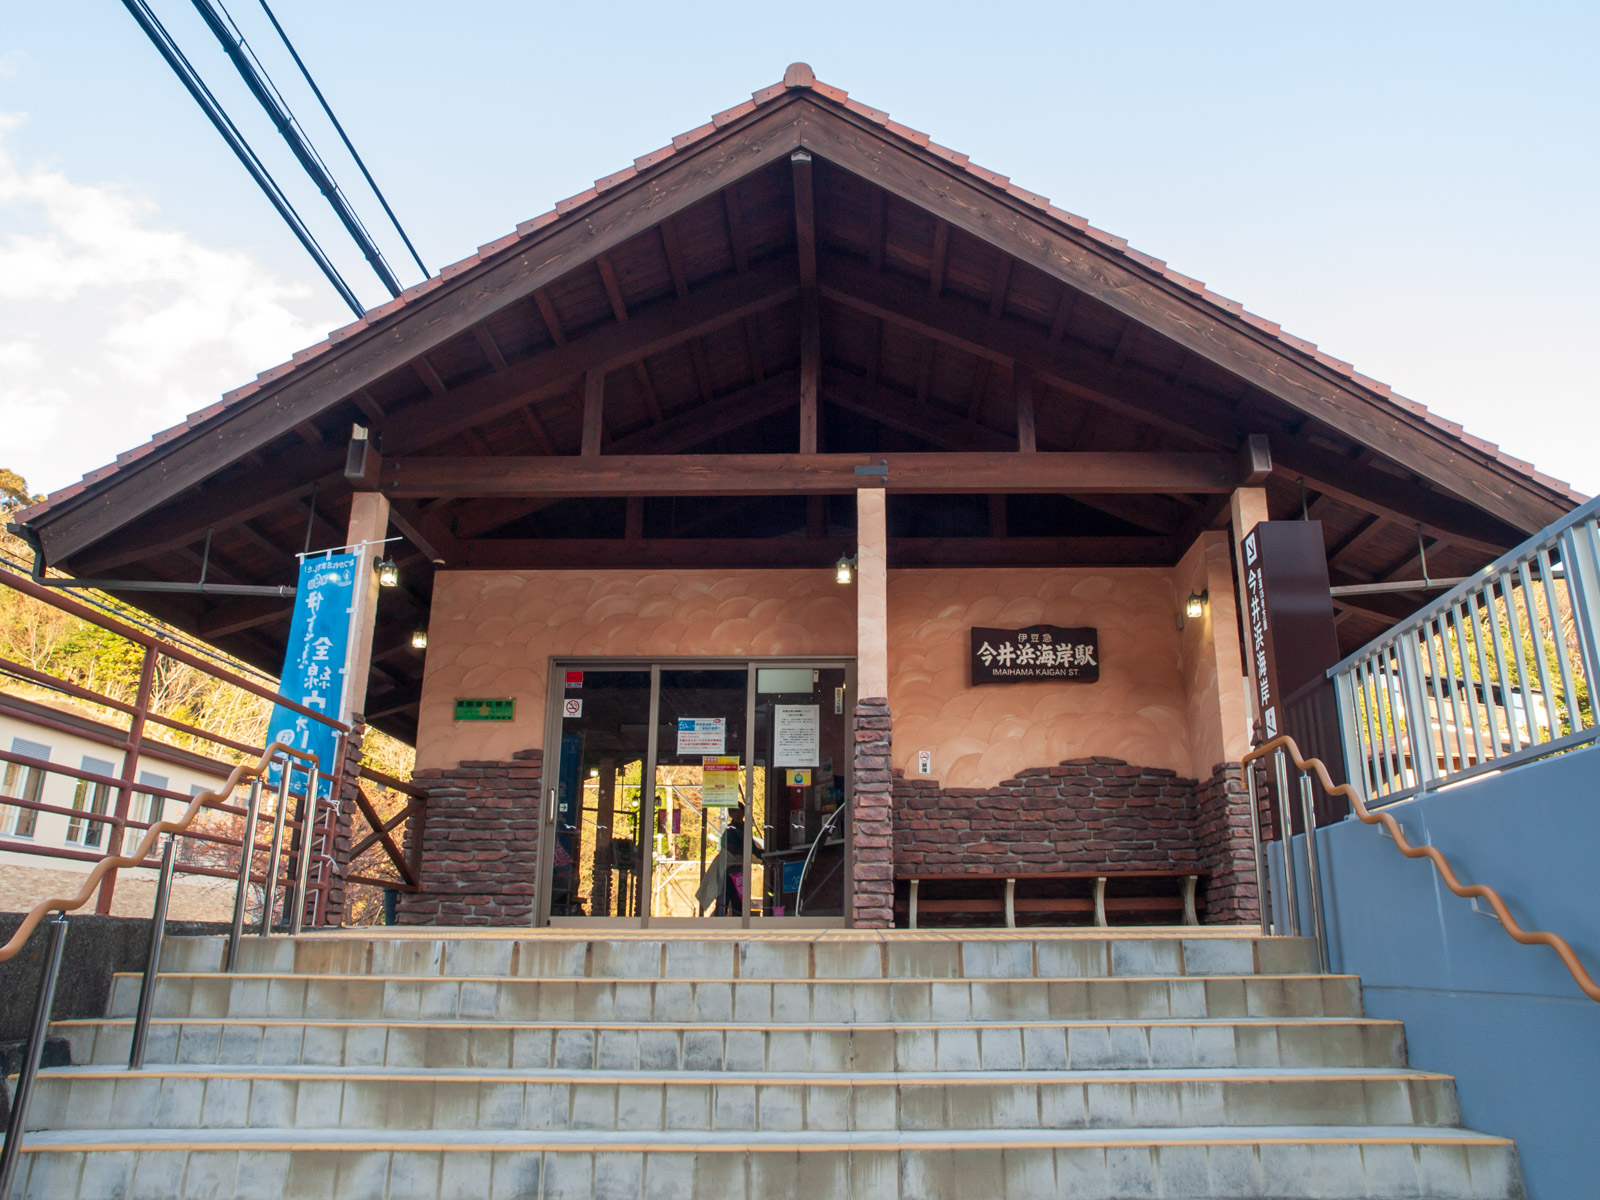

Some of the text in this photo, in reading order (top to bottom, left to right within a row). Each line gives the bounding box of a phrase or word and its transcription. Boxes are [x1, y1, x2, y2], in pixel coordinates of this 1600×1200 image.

[1017, 633, 1052, 643] 伊豆急
[1247, 568, 1270, 707] 今井浜海岸
[976, 641, 1097, 667] 今井浜海岸駅
[992, 668, 1081, 676] IMAIHAMA KAIGAN ST.
